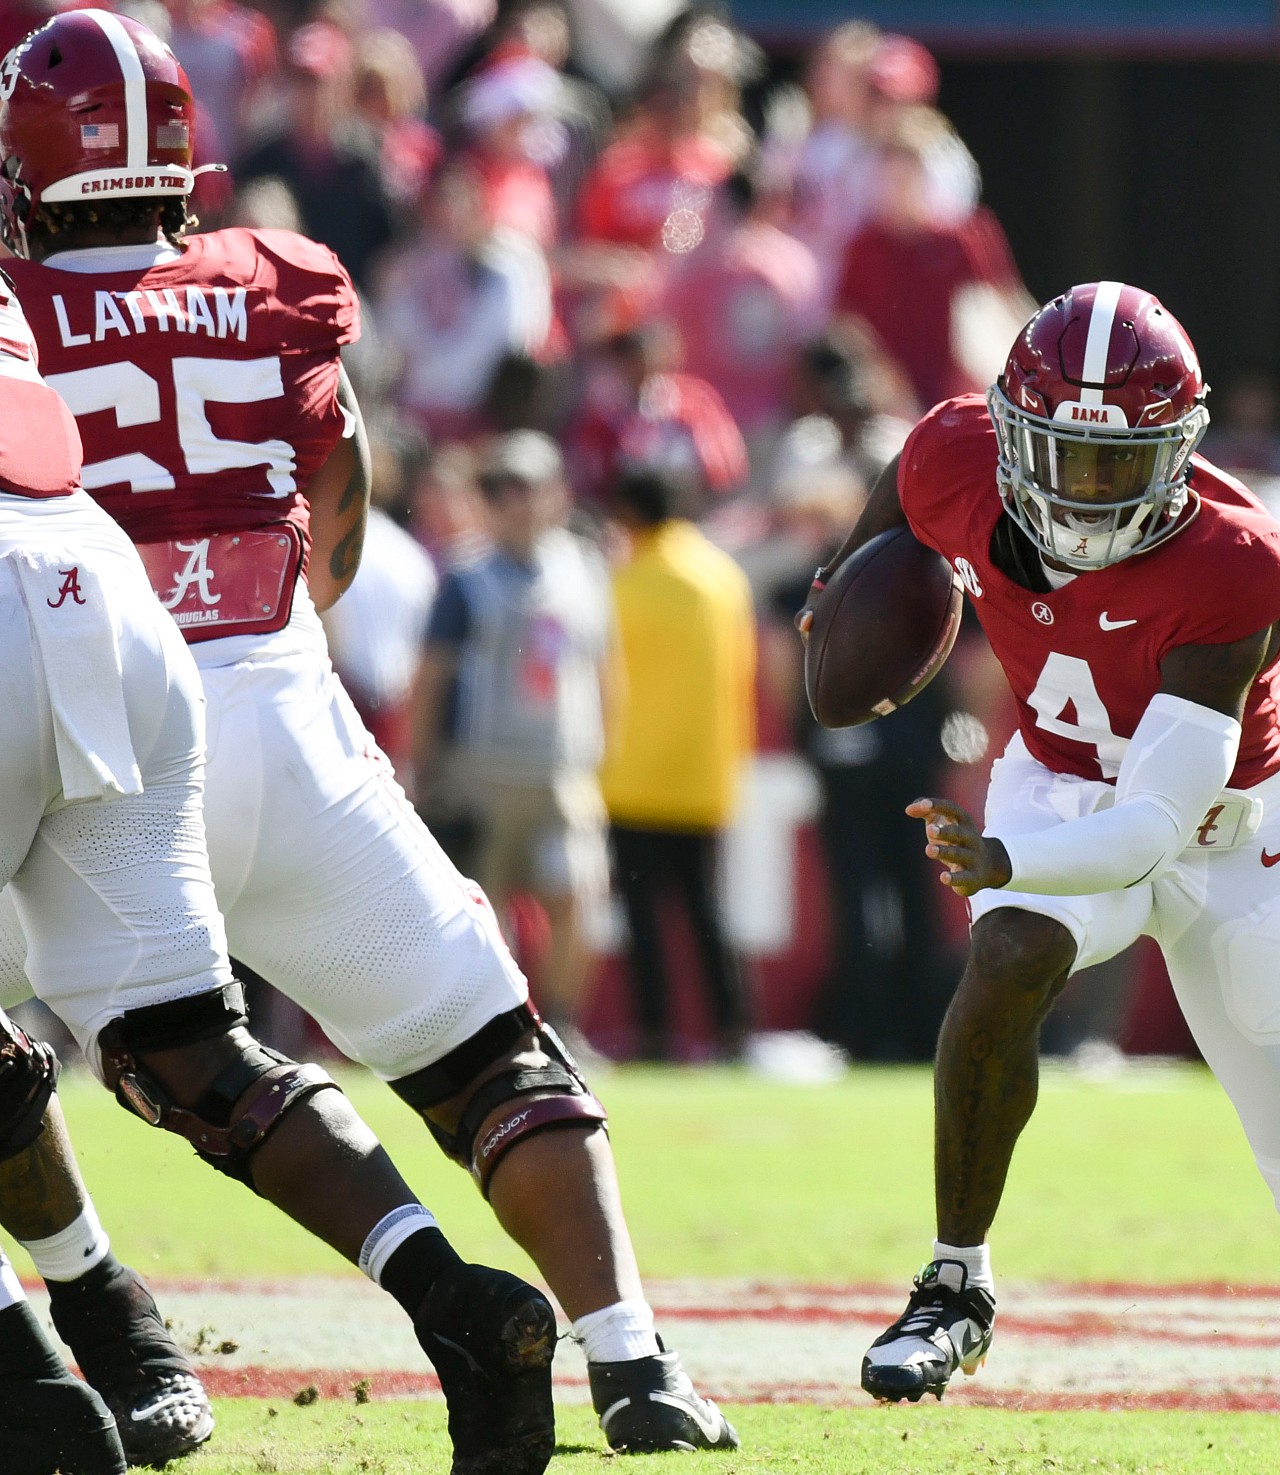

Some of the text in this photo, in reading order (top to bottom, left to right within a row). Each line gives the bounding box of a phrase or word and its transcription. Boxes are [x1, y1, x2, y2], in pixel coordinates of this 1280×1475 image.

[81, 176, 186, 194] CRIMSON TIDE
[52, 287, 248, 348] LATHAM
[1071, 406, 1109, 424] BAMA
[47, 566, 86, 609] A
[174, 609, 219, 624] DOUGLAS
[1027, 651, 1132, 779] 4
[482, 1109, 532, 1158] DONJOY
